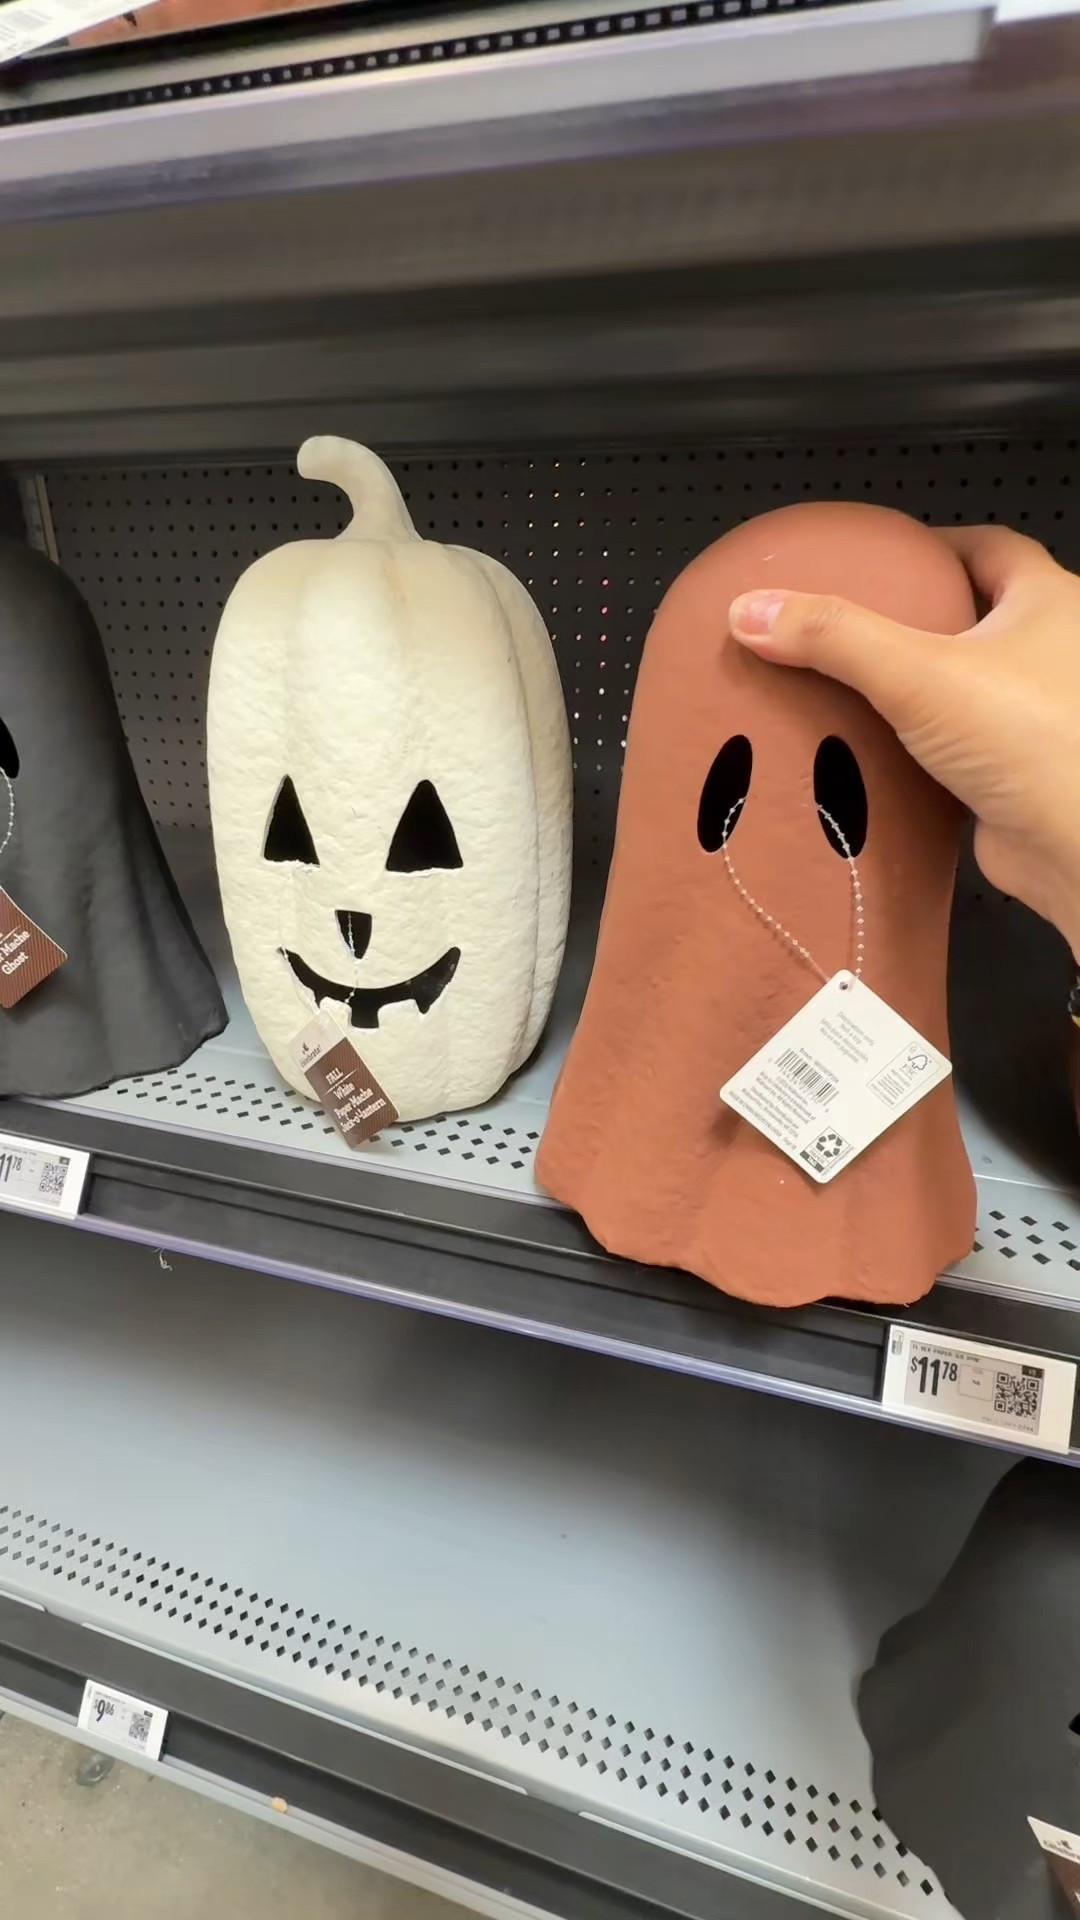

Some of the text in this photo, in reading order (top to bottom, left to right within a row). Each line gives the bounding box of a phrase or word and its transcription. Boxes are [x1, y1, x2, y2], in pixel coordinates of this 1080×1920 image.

[0, 931, 30, 956] Mache
[2, 952, 28, 974] Ghost
[326, 1068, 343, 1085] FALL
[333, 1083, 355, 1100] White
[334, 1088, 373, 1120] Paper Mache
